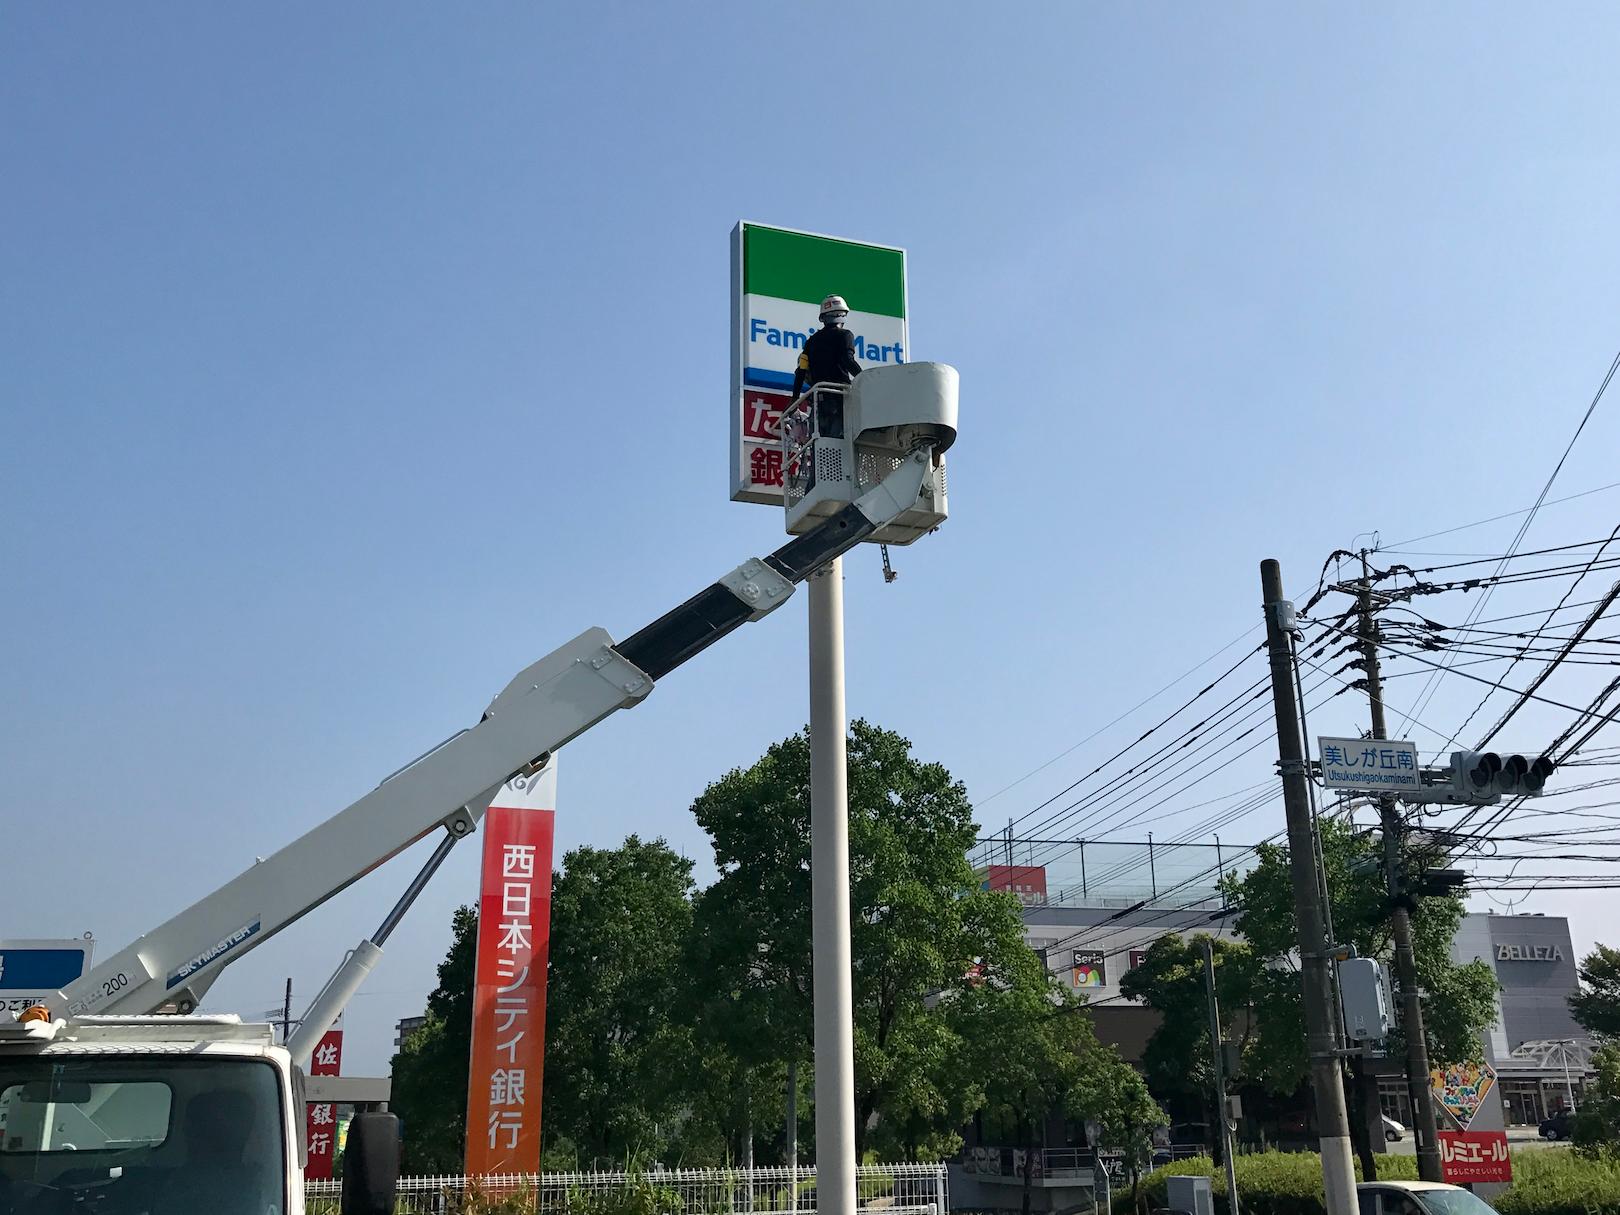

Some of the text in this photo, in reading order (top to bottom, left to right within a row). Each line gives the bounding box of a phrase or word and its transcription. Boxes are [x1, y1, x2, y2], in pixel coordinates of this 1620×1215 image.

[751, 319, 904, 364] FamMart
[1325, 745, 1414, 770] 美しが丘南
[1328, 769, 1416, 784] Utsukushigaokaminami
[178, 926, 251, 977] SKYMASTER
[1075, 954, 1103, 964] Seria
[1497, 944, 1565, 961] BELLEZA
[103, 973, 127, 996] 200
[487, 844, 536, 1150] 西日本シティ銀行
[308, 1043, 338, 1155] 佐銀行
[1439, 1139, 1508, 1163] ルミエール
